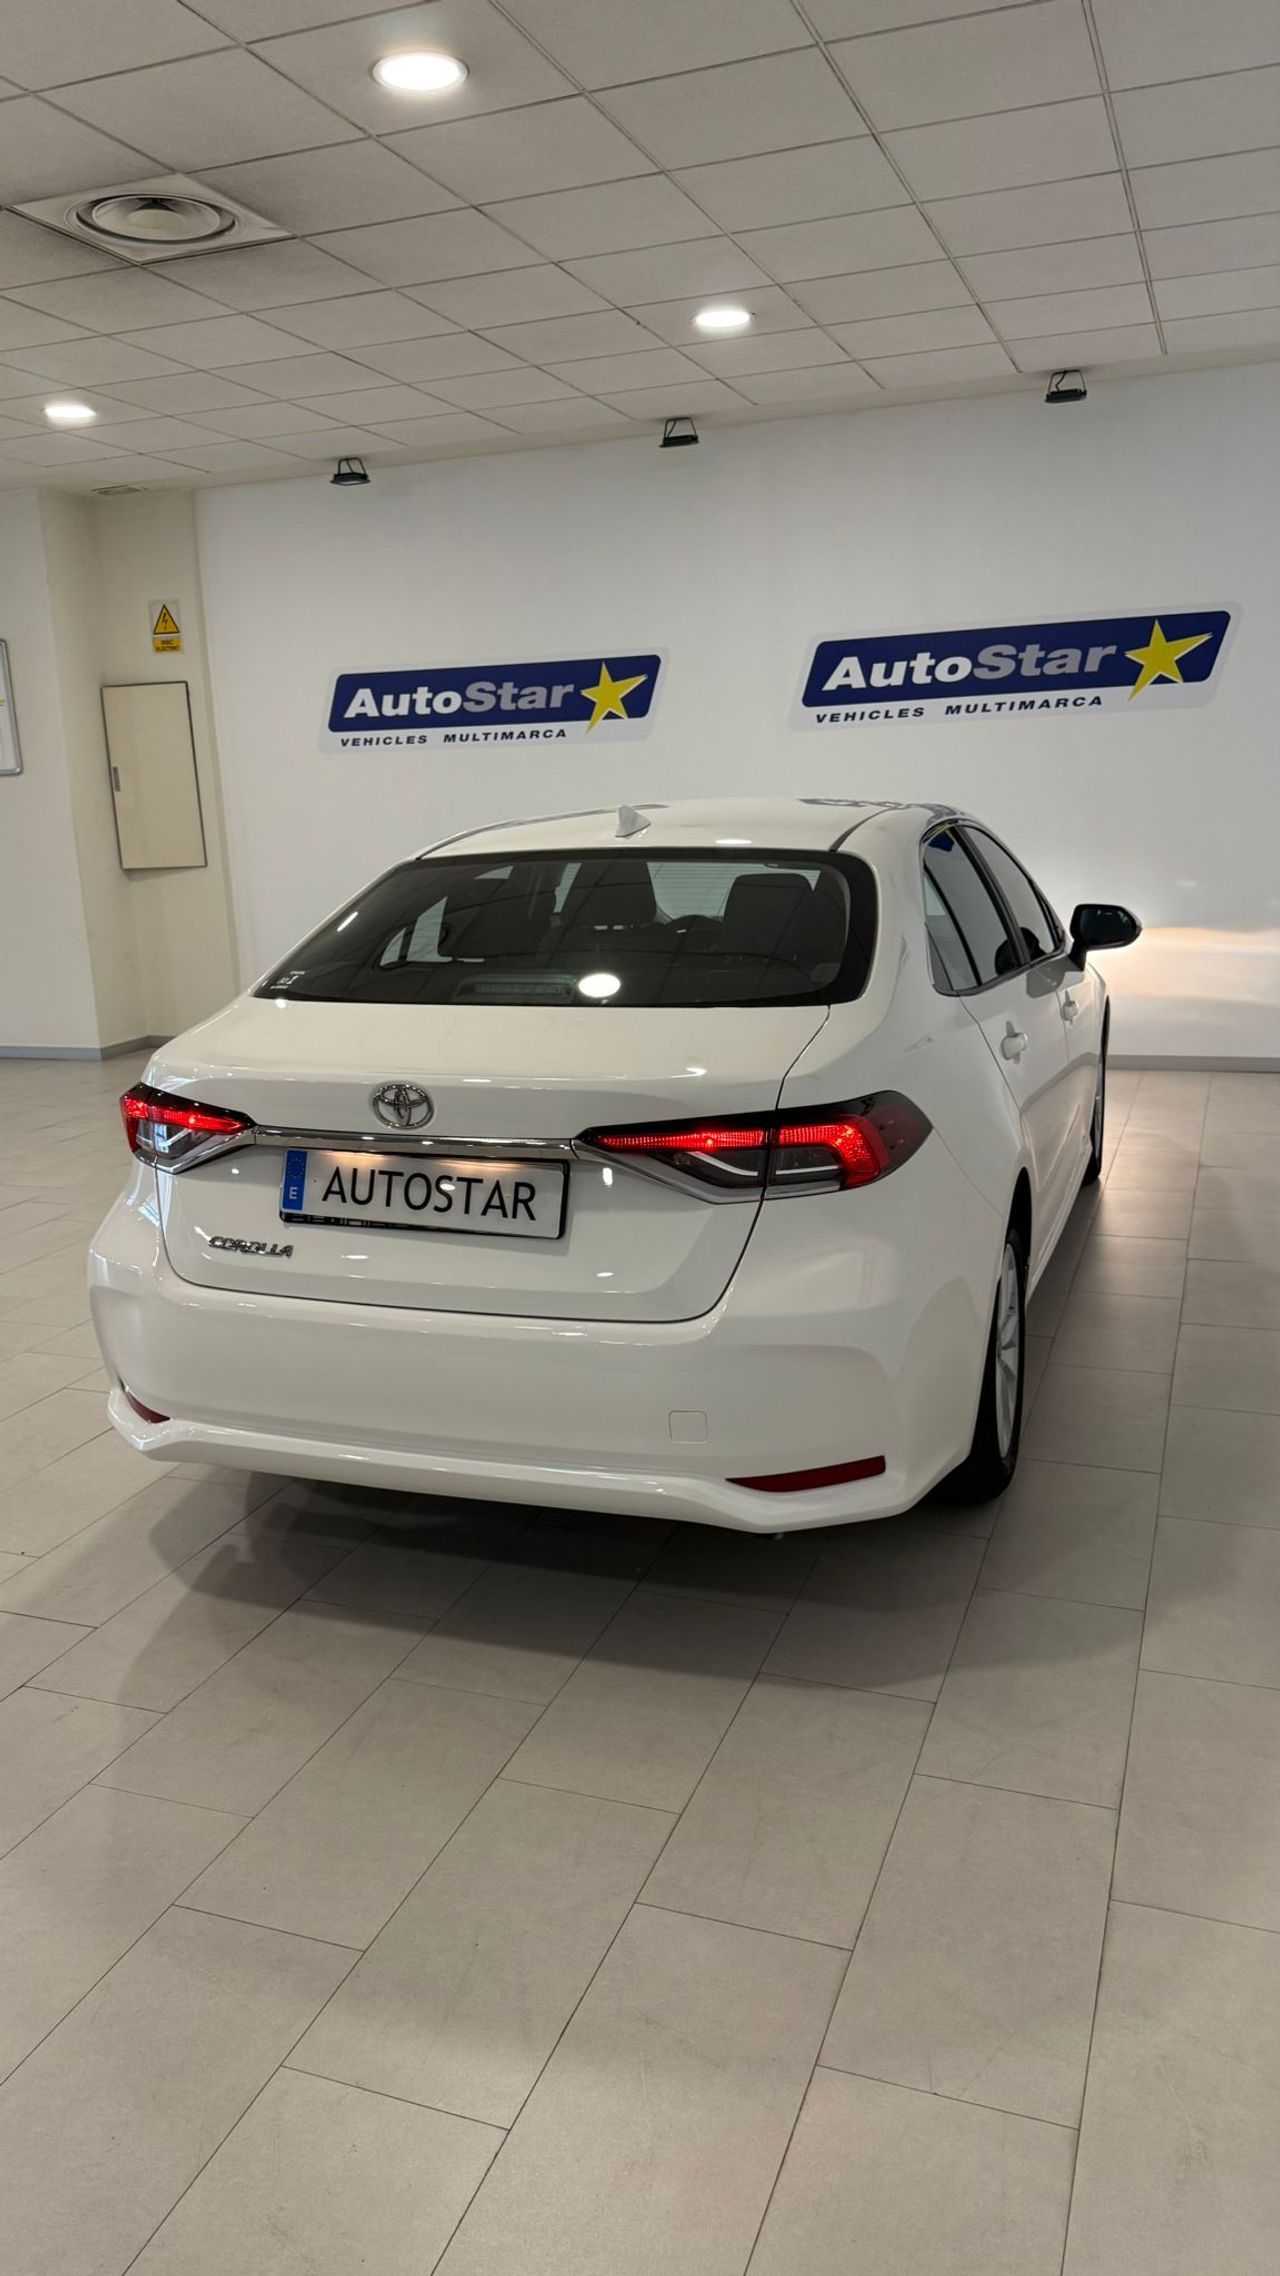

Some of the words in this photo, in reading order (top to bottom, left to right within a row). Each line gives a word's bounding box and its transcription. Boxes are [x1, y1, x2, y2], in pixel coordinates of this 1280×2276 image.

[821, 644, 1117, 691] AutoStar
[343, 681, 575, 719] AutoStar
[815, 706, 925, 723] VEHICLES
[944, 696, 1103, 715] MULTIMARCA
[340, 734, 428, 747] VEHICLES
[443, 728, 567, 743] MULTIMARCA
[288, 1186, 299, 1200] E
[321, 1166, 537, 1221] AUTOSTAR
[208, 1236, 294, 1258] COROLLA
